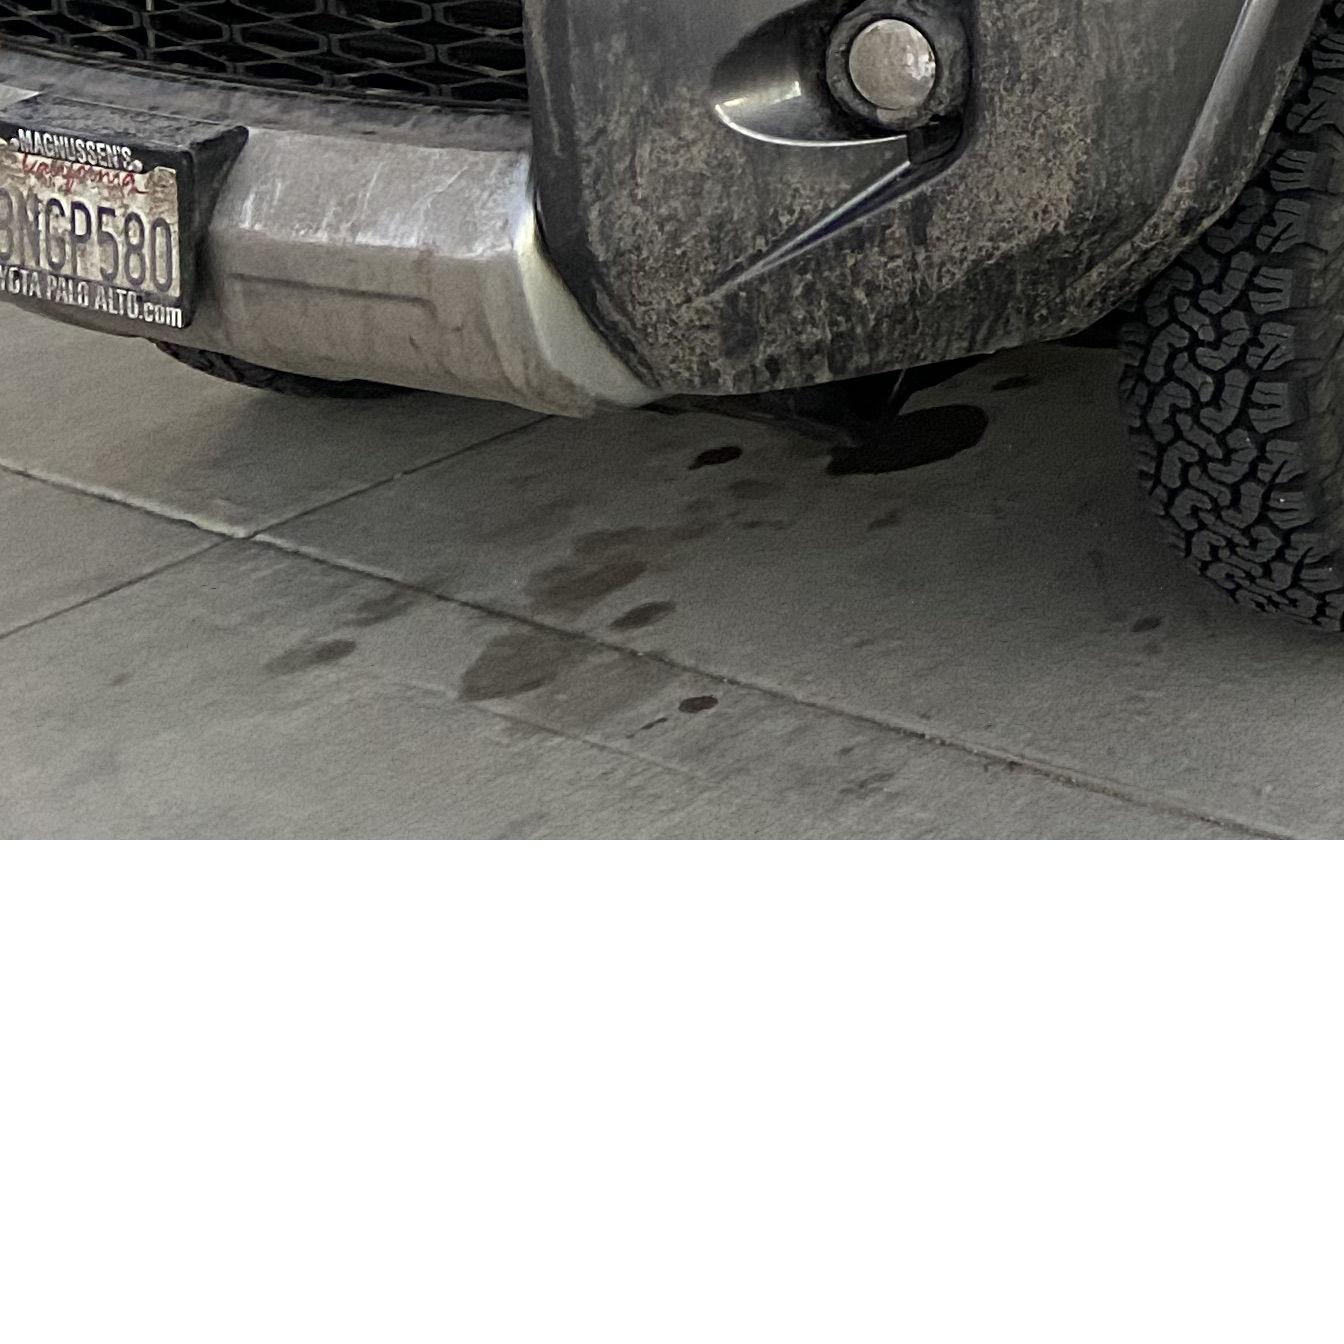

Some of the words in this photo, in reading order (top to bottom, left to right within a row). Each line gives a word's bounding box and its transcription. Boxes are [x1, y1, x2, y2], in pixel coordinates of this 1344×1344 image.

[18, 128, 133, 170] MAGNUSSEN'S
[47, 274, 89, 308] PALO
[95, 285, 184, 329] ALTO.com
